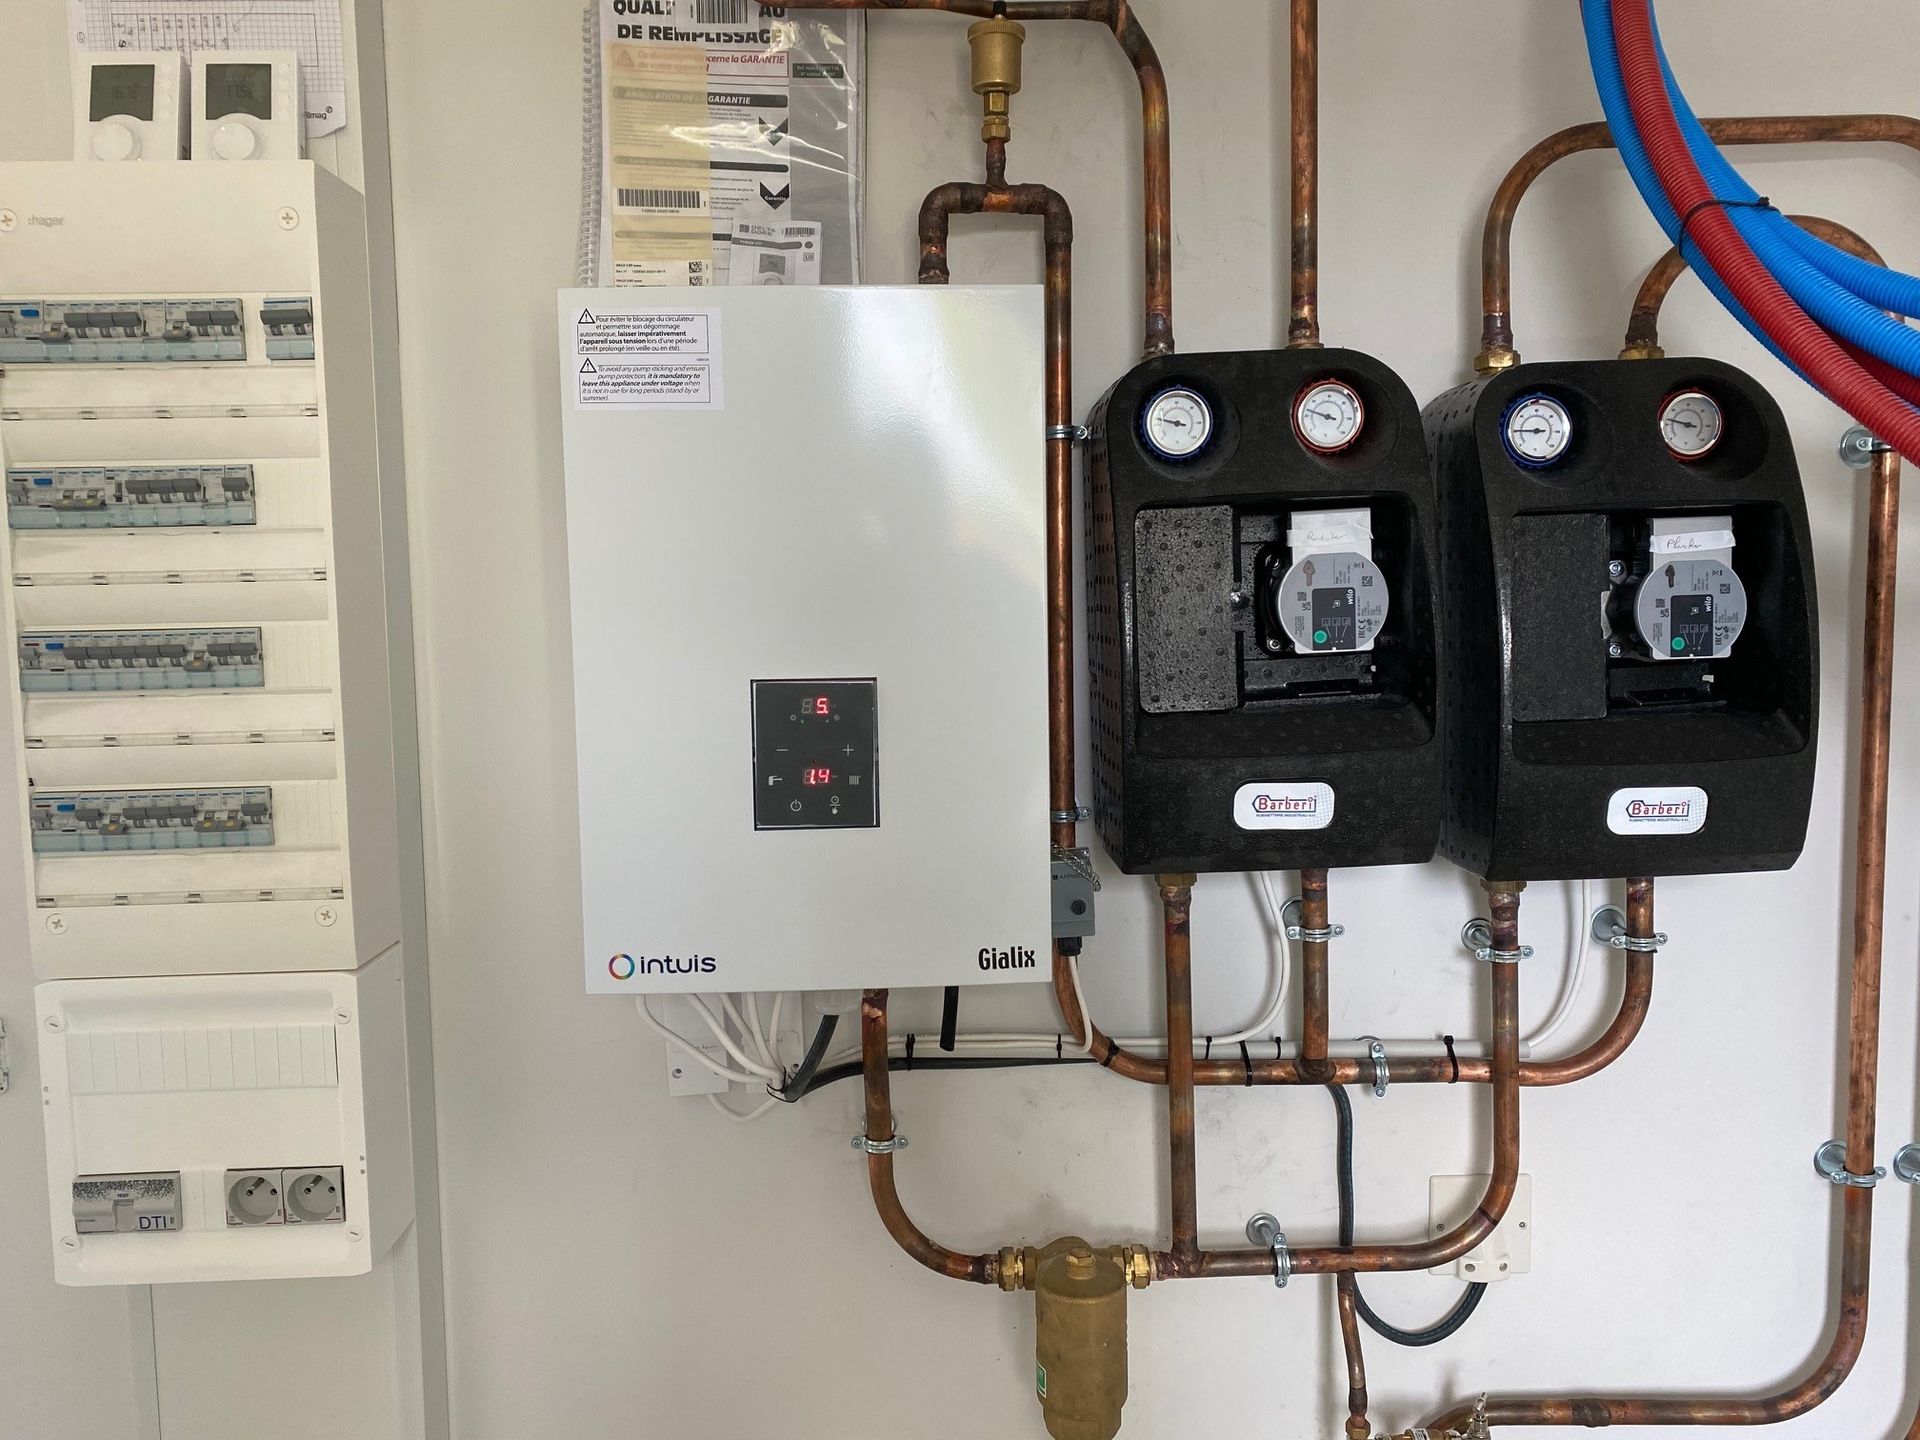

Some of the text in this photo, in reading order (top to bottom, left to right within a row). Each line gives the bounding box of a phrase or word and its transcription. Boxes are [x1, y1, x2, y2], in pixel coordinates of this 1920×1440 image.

[617, 24, 783, 44] DE REMPLISSAGE
[731, 55, 739, 63] la
[740, 55, 785, 64] GARANTIE
[708, 95, 751, 104] GARANTIE
[633, 315, 656, 323] blocage
[643, 323, 681, 331] dégommage
[637, 330, 687, 338] impérativement
[675, 337, 698, 345] période
[651, 365, 674, 373] sticking
[611, 380, 641, 388] appliance
[660, 380, 684, 388] voltage
[643, 387, 665, 395] periods
[1258, 795, 1314, 810] Barberi
[1632, 800, 1687, 815] Barberi
[978, 946, 1036, 970] Gialix
[640, 954, 717, 974] intuis
[139, 1215, 167, 1230] DTI
